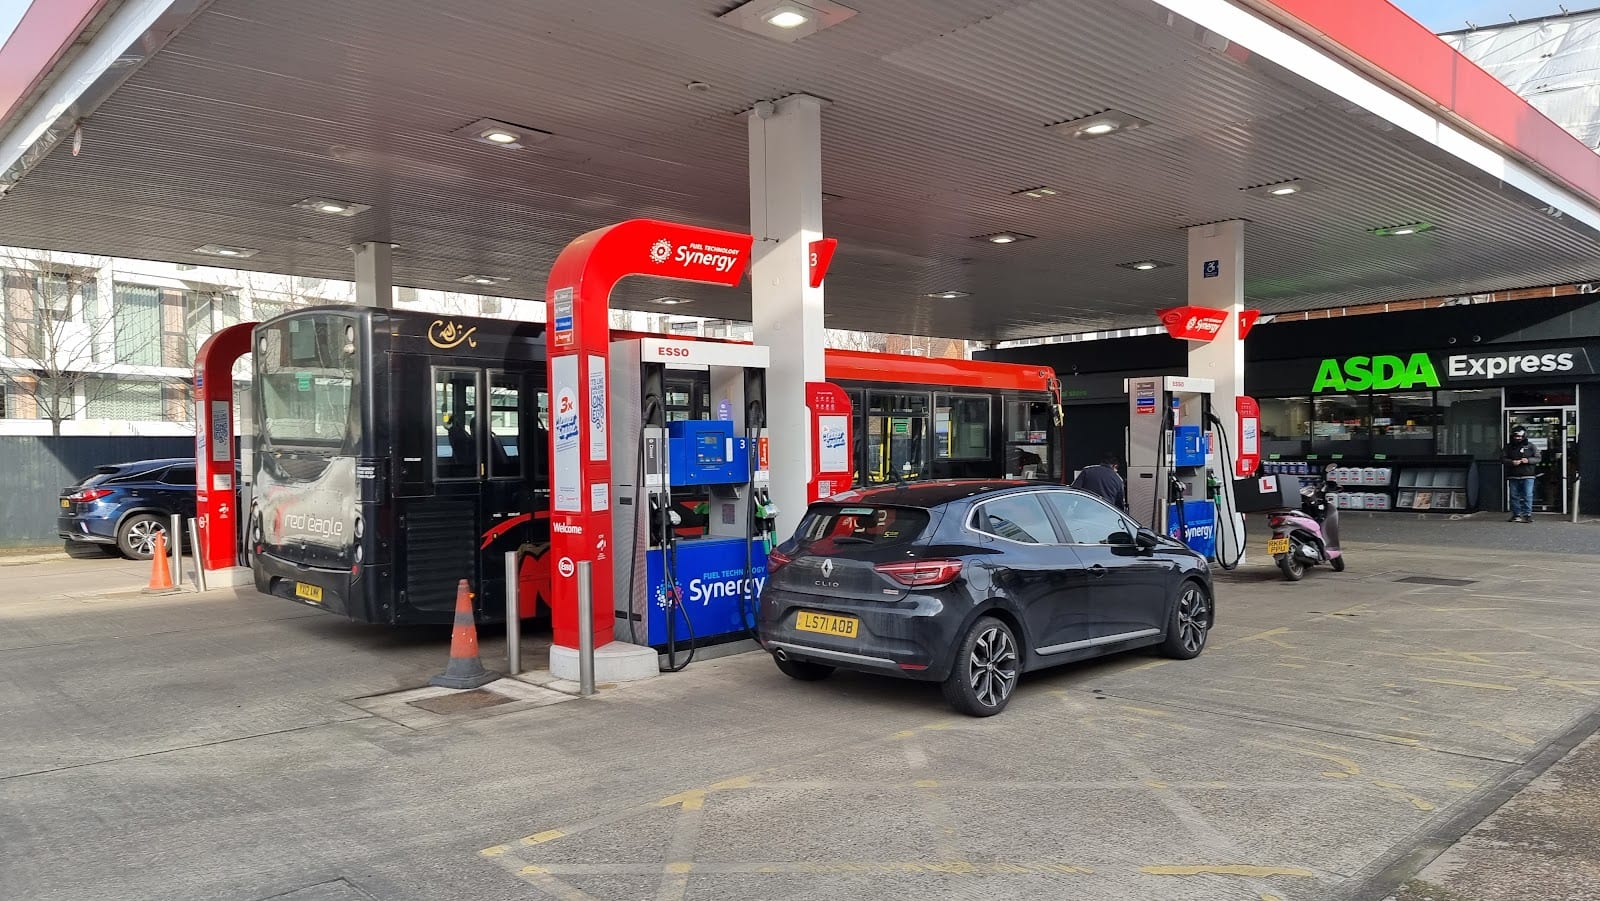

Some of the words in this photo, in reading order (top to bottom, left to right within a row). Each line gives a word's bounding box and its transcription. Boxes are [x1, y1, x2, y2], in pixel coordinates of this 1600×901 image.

[704, 245, 740, 255] TECHNOLOGY
[674, 245, 737, 273] Synergy
[810, 252, 818, 266] 3
[1196, 319, 1220, 334] Synergy
[1241, 318, 1246, 327] 1
[658, 347, 690, 357] ESSO
[1311, 352, 1441, 392] ASDA
[1448, 352, 1574, 379] Express
[739, 439, 746, 449] 3
[1263, 478, 1273, 490] L
[284, 513, 306, 529] red
[307, 517, 343, 538] eagle
[553, 522, 583, 534] Welcome
[560, 562, 573, 571] Esso
[703, 570, 721, 580] FUEL
[814, 580, 840, 588] CLIO
[689, 576, 766, 606] Synergy
[805, 615, 828, 632] LS71
[831, 617, 853, 634] AOB
